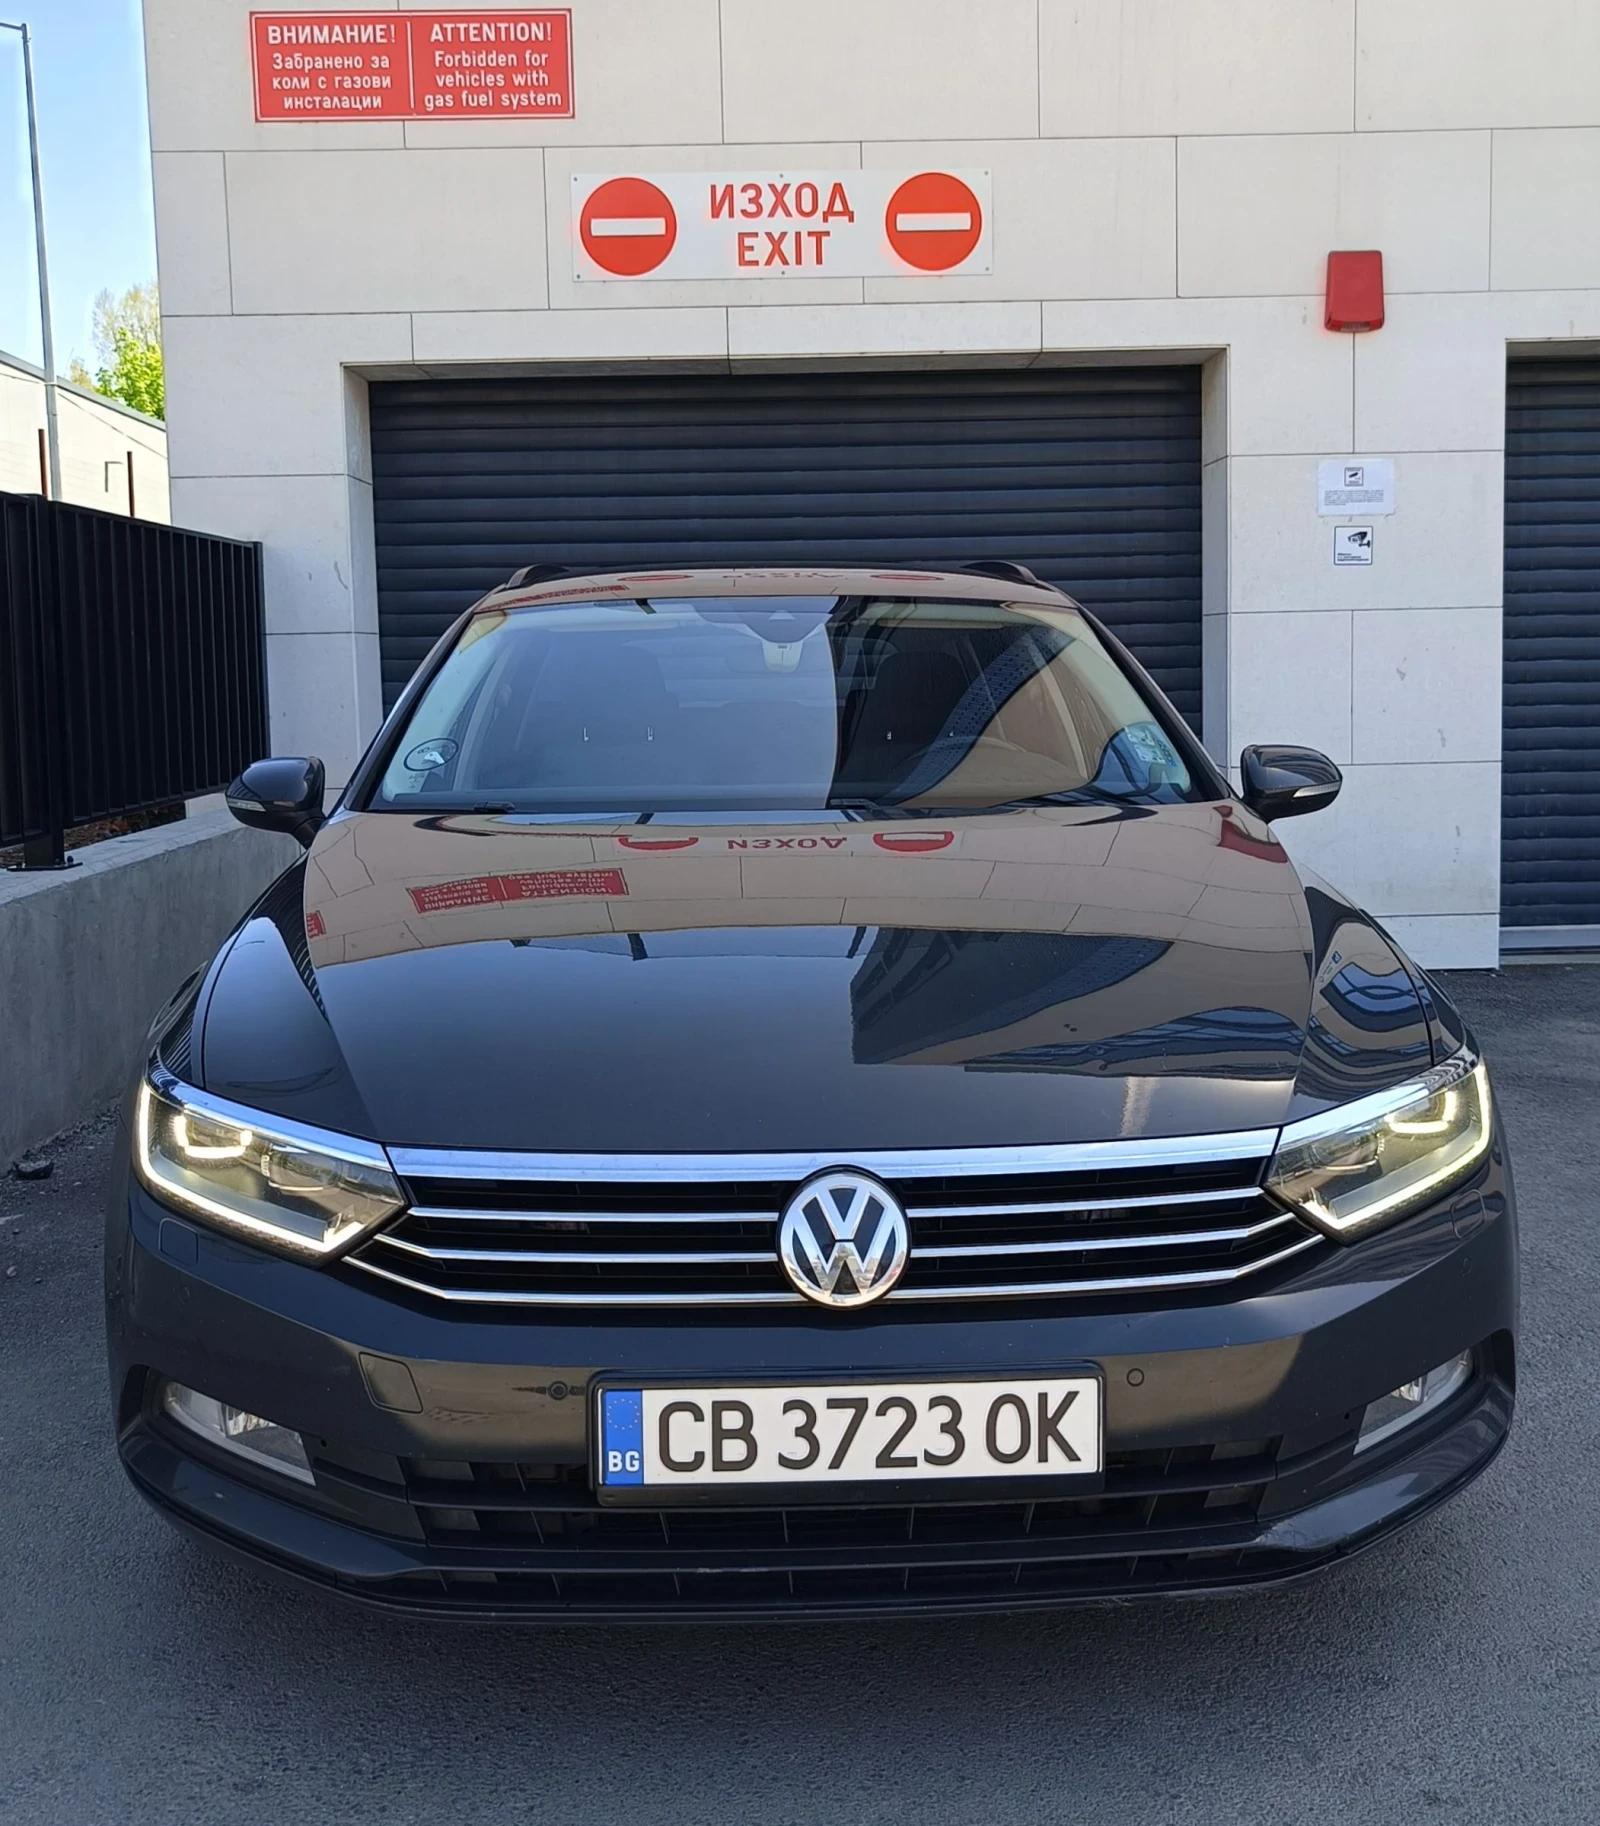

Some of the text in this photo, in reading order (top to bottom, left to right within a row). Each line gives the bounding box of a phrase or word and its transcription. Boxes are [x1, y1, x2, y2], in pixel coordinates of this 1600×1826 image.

[267, 24, 396, 44] ВНИМАНИЕ!
[430, 22, 552, 43] ATTENTION!
[272, 52, 390, 74] Забранено за
[434, 50, 548, 68] Forbidden for
[272, 75, 392, 90] коли с газови
[436, 69, 549, 88] vehicles with
[284, 95, 382, 112] инсталации
[424, 90, 562, 112] gas fuel system
[710, 182, 855, 224] ИЗХОД
[738, 230, 831, 266] EXIT
[658, 1391, 1082, 1472] CB 3723 OK
[608, 1450, 640, 1473] BG
